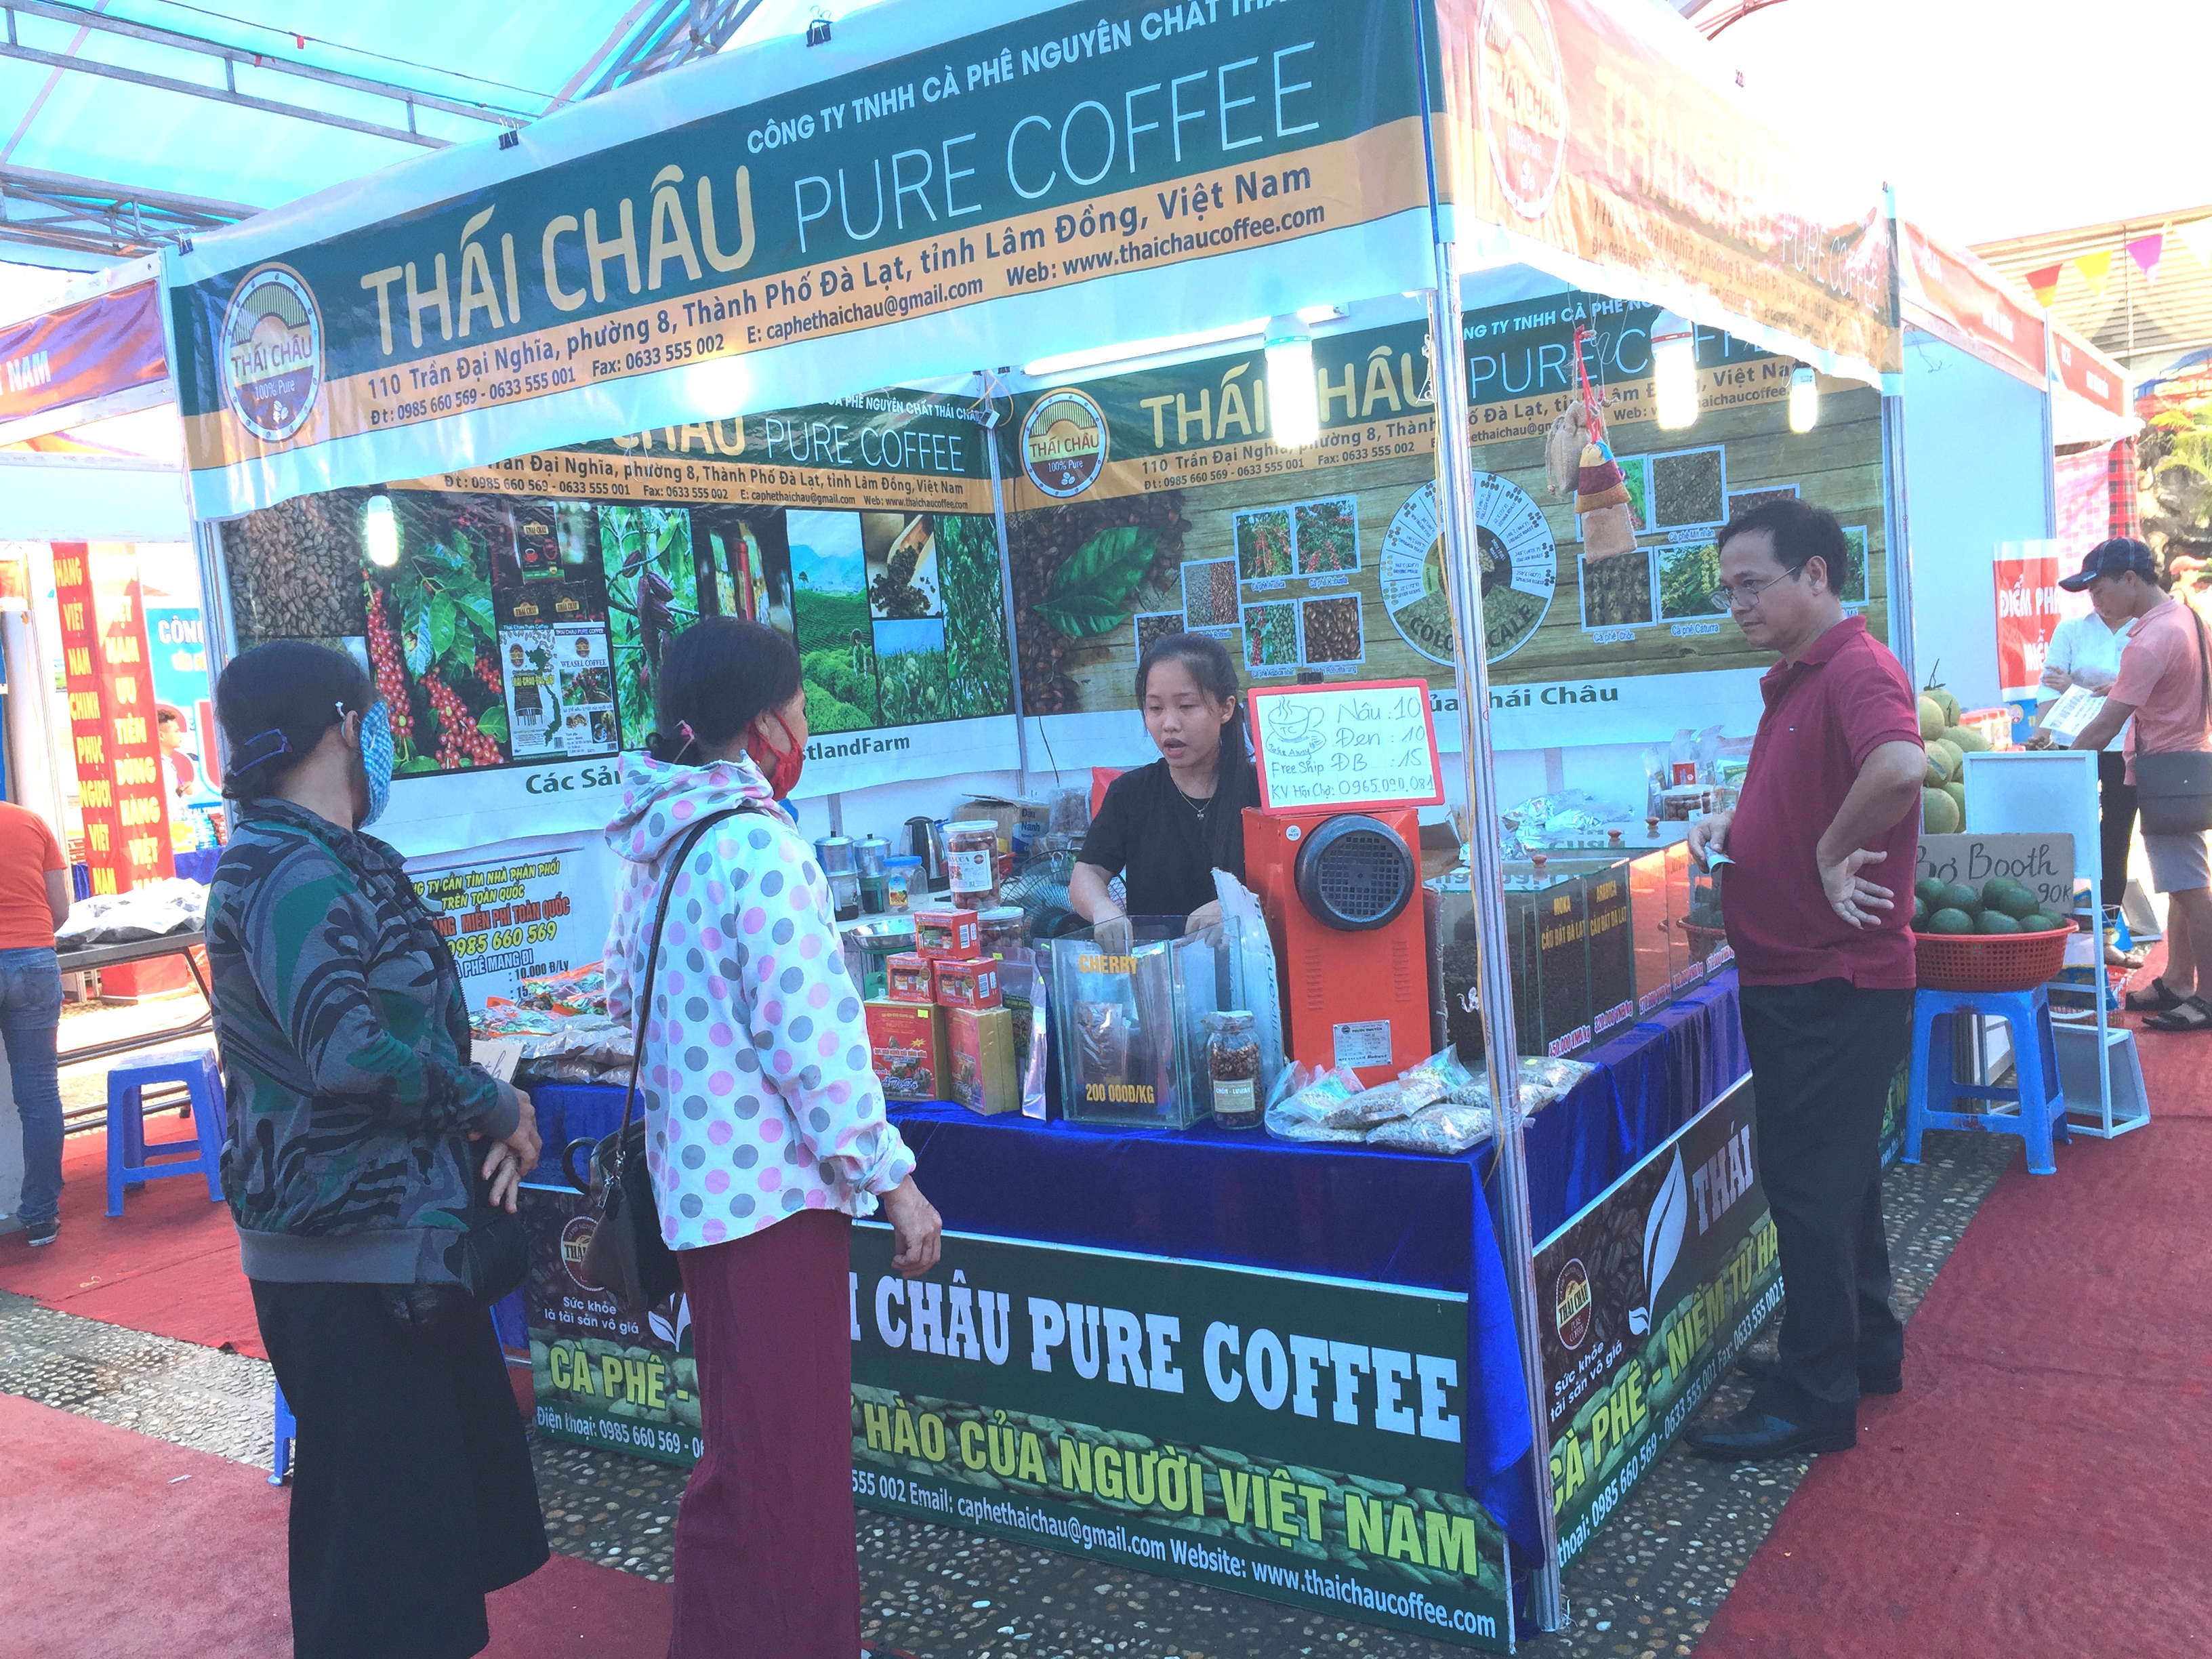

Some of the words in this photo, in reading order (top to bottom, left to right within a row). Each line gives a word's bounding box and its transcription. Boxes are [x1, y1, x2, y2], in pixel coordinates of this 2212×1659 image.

[747, 119, 815, 154] CÔNG
[820, 102, 846, 132] TY
[851, 82, 915, 123] TNHH
[922, 66, 960, 103] CÀ
[966, 47, 1015, 91] PHÊ
[1022, 20, 1132, 76] NGUYÊN
[361, 203, 521, 356] THÁI
[544, 164, 756, 312] CHÂU
[794, 132, 982, 253] PURE
[1007, 41, 1319, 199] COFFEE
[368, 373, 401, 399] 110
[409, 360, 451, 389] Trần
[456, 350, 489, 382] Đại
[494, 338, 560, 373] Nghĩa,
[567, 319, 649, 360] phường
[657, 310, 678, 335] 8,
[683, 289, 757, 327] Thành
[765, 270, 813, 309] Phố
[819, 265, 855, 298] Đà
[863, 255, 913, 291] Lạt,
[920, 243, 975, 274] tỉnh
[985, 226, 1045, 259] Lâm
[1055, 203, 1149, 245] Đồng,
[1158, 181, 1223, 223] Việt
[1235, 165, 1311, 203] Nam
[397, 398, 427, 420] 0985
[430, 394, 452, 413] 660
[455, 388, 477, 407] 569
[489, 380, 522, 401] 0633
[525, 372, 548, 393] 555
[552, 367, 576, 387] 001
[592, 359, 621, 377] Fax:
[626, 349, 661, 371] 0633
[665, 341, 692, 362] 555
[697, 333, 724, 353] 002
[747, 325, 761, 344] E:
[766, 276, 983, 341] caphethaichau@gmail.com
[1006, 264, 1057, 287] Web:
[1063, 203, 1326, 275] www.thaichaucoffee.com
[1513, 310, 1556, 331] TNHH
[6, 350, 52, 392] NAM
[230, 342, 269, 377] THÁI
[271, 331, 312, 370] CHÂU
[254, 380, 276, 401] 100%
[277, 377, 295, 395] Pure
[866, 396, 903, 414] NGUYÊN
[906, 398, 935, 417] CHẤT
[1140, 361, 1264, 449] THÁI
[1175, 452, 1208, 470] Trần
[1212, 449, 1237, 468] Đại
[1514, 401, 1549, 420] Lạt,
[1713, 365, 1755, 387] Việt
[766, 418, 853, 464] PURE
[861, 428, 964, 472] COFFEE
[1029, 434, 1061, 458] THÁI
[1063, 431, 1099, 453] CHÂU
[1342, 449, 1368, 463] 0633
[1393, 442, 1415, 455] 002
[530, 455, 559, 480] Đại
[565, 457, 618, 478] Nghĩa,
[623, 461, 682, 484] phường
[703, 466, 746, 483] Thành
[750, 468, 776, 485] Phố
[800, 472, 824, 492] Lạt,
[881, 475, 914, 495] Đồng,
[916, 478, 938, 496] Việt
[941, 482, 964, 496] Nam
[471, 476, 501, 491] 0985
[611, 483, 630, 495] 001
[751, 489, 855, 506] caphethaichau@gmail.com
[885, 495, 968, 511] www.thaichaucoffee.com
[54, 552, 83, 587] HÀNG
[1999, 574, 2032, 619] ĐIỂM
[67, 647, 92, 676] NAM
[1338, 698, 1380, 723] Nâu
[1540, 684, 1618, 705] Châu
[114, 708, 147, 745] TIÊN
[1336, 727, 1380, 748] Đen
[77, 736, 105, 771] PHỤC
[114, 750, 157, 786] DÙNG
[1331, 752, 1367, 771] ĐB
[526, 769, 575, 796] Các
[1271, 785, 1289, 799] KV
[119, 790, 161, 827] HÀNG
[441, 872, 463, 892] CẦN
[466, 870, 485, 888] TÌM
[487, 867, 508, 884] NHÀ
[509, 863, 536, 881] PHÂN
[539, 857, 560, 877] PHỐI
[1968, 842, 2059, 880] Booth
[441, 893, 468, 911] TRÊN
[472, 887, 497, 906] TOÀN
[499, 881, 525, 901] QUỐC
[462, 906, 491, 934] MIỄN
[493, 902, 512, 928] PHÍ
[542, 891, 571, 920] QUỐC
[492, 928, 523, 951] 660
[527, 921, 557, 943] 569
[487, 951, 520, 974] MANG
[520, 948, 534, 965] ĐI
[515, 964, 546, 981] 10.000
[1079, 954, 1137, 975] CHERRY
[1085, 1084, 1105, 1102] 200
[1692, 1120, 1754, 1235] THÁI
[563, 1295, 586, 1311] Sức
[588, 1298, 617, 1315] khỏe
[1559, 1295, 1574, 1324] THÁI
[1574, 1283, 1589, 1311] CHÂU
[544, 1309, 556, 1321] là
[558, 1311, 575, 1324] tài
[577, 1312, 599, 1329] sản
[602, 1317, 617, 1331] vô
[619, 1321, 640, 1336] giá
[875, 1269, 1010, 1366] CHÂU
[1027, 1296, 1184, 1394] PURE
[1203, 1320, 1461, 1443] COFFEE
[1555, 1370, 1576, 1397] Sức
[1578, 1342, 1604, 1374] khỏe
[1592, 1358, 1647, 1469] PHÊ
[1666, 1282, 1726, 1382] NIỀM
[549, 1341, 595, 1396] CÀ
[600, 1354, 666, 1410] PHÊ
[863, 1394, 947, 1464] HÀO
[959, 1409, 1048, 1487] CỦA
[1059, 1435, 1205, 1518] NGƯỜI
[1218, 1468, 1328, 1548] VIỆT
[1344, 1492, 1479, 1578] NAM
[1592, 1477, 1619, 1528] 0985
[1664, 1397, 1685, 1438] 0633
[537, 1406, 562, 1433] Điện
[565, 1410, 598, 1441] thoại:
[599, 1419, 631, 1444] 0985
[633, 1425, 655, 1449] 660
[658, 1431, 681, 1454] 569
[880, 1474, 905, 1502] 002
[909, 1482, 954, 1513] Email:
[958, 1496, 1166, 1561] caphethaichau@gmail.com
[1170, 1538, 1247, 1578] Website:
[1251, 1561, 1496, 1639] www.thaichaucoffee.com
